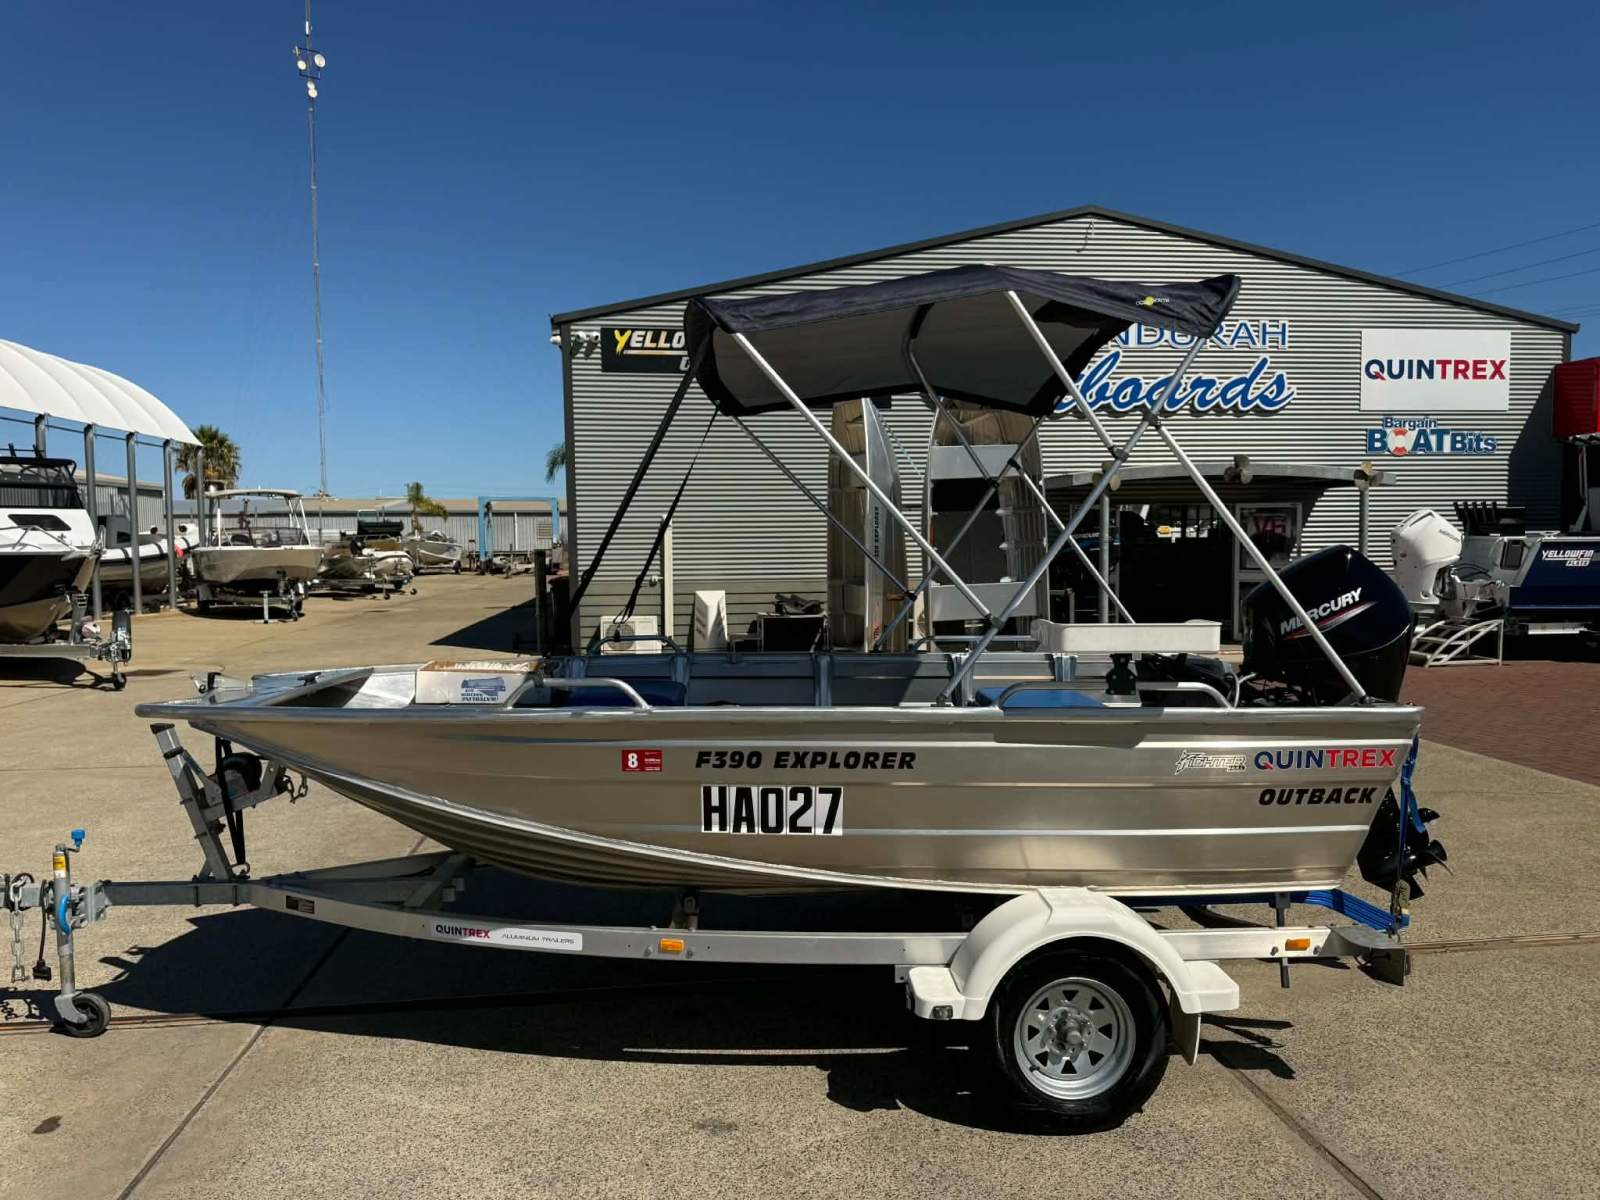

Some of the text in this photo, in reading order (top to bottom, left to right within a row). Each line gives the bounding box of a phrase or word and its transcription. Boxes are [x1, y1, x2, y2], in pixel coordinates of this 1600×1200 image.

[1364, 359, 1507, 381] QUINTREX
[1383, 417, 1437, 430] Bargain
[1542, 550, 1594, 560] YELLOWFIN
[628, 753, 638, 768] 8
[695, 751, 916, 770] F390 EXPLORER
[1254, 748, 1396, 770] QUINTREX
[1258, 787, 1377, 805] OUTBACK
[436, 924, 491, 939] QUINTREX
